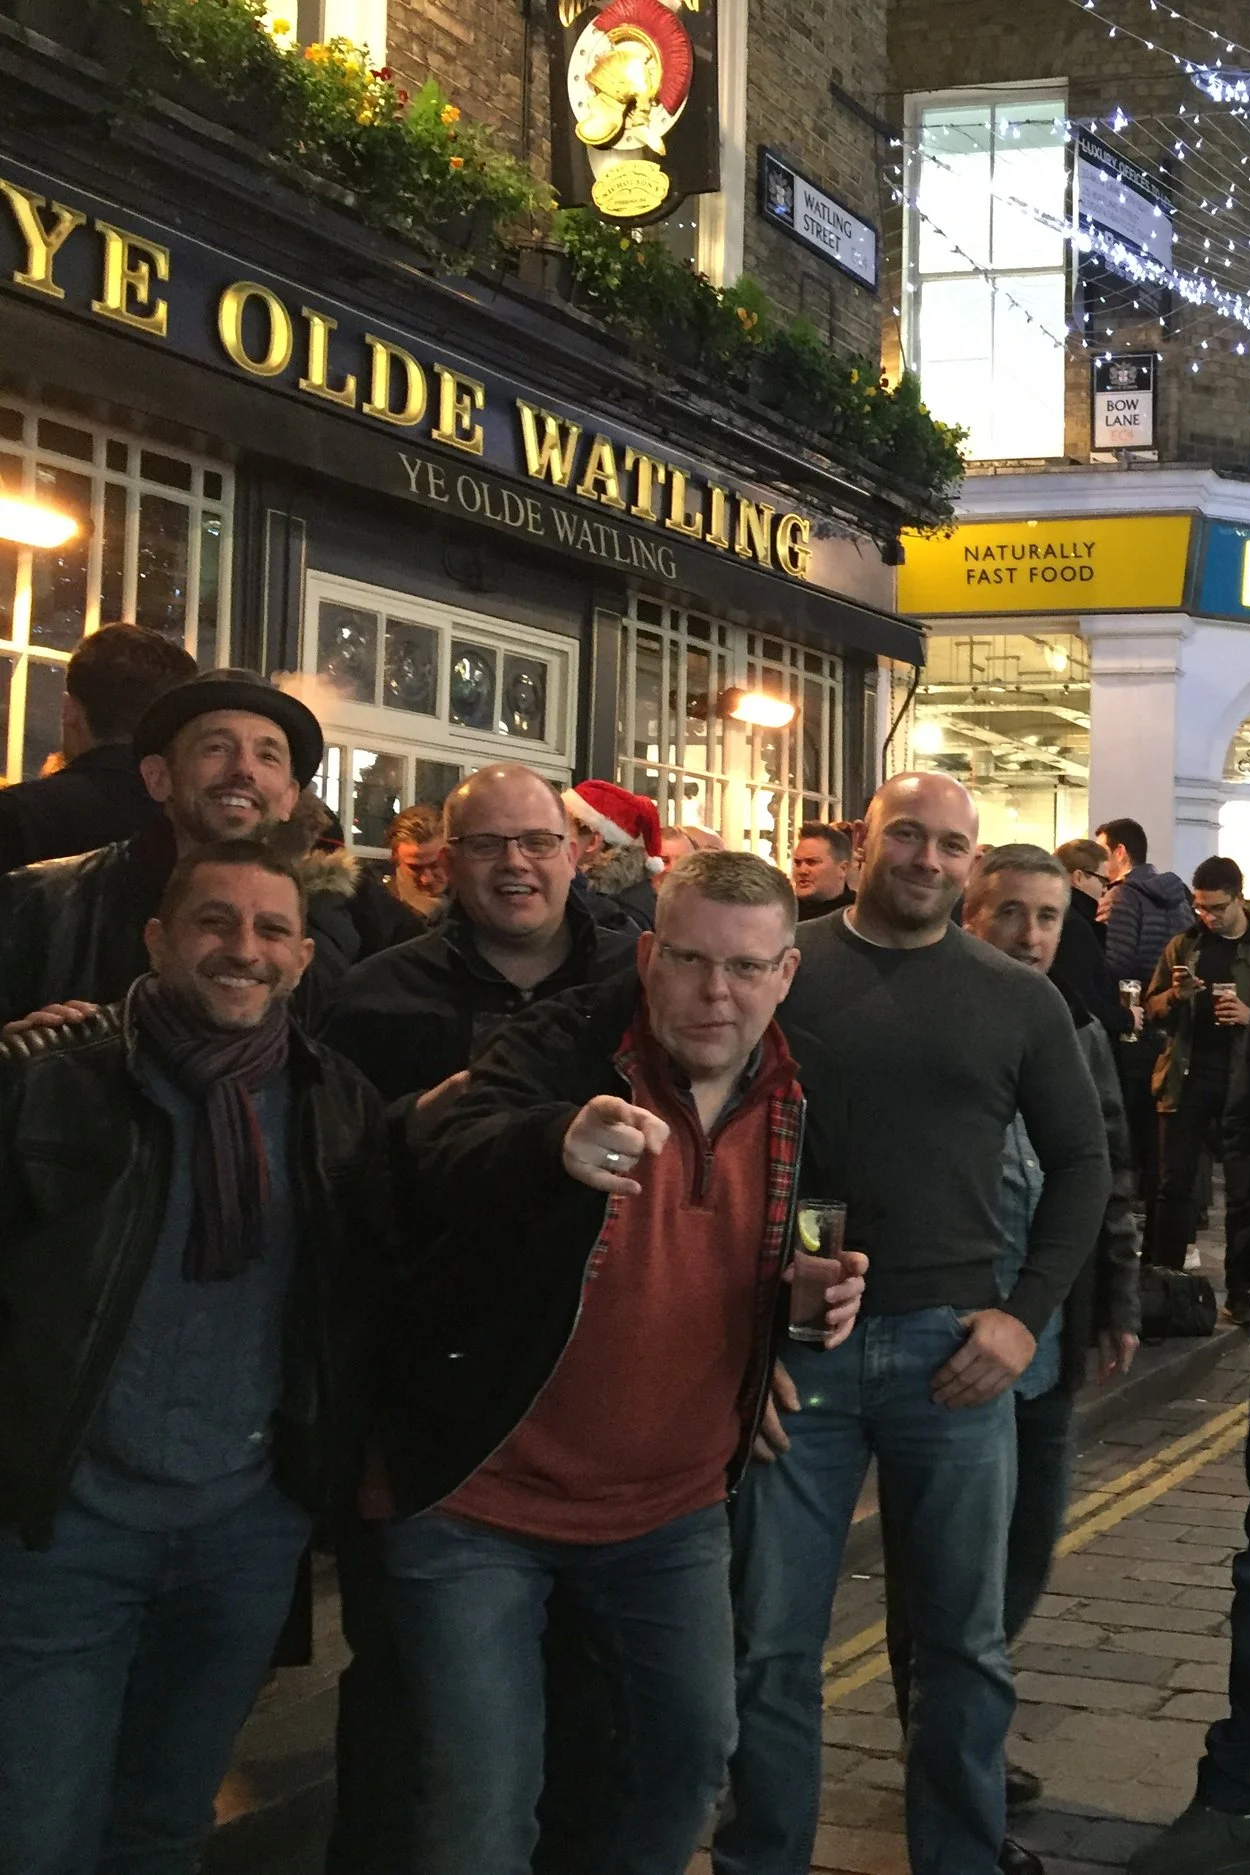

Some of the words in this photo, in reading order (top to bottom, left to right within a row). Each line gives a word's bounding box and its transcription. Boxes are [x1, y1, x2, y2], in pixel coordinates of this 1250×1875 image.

[1082, 138, 1118, 168] LUXURY
[1119, 161, 1150, 190] OFFICES
[803, 189, 853, 240] WATLING
[803, 213, 842, 253] STREET
[0, 176, 170, 338] YE
[217, 279, 486, 456] OLDE
[515, 397, 813, 581] WATLING
[1105, 414, 1140, 427] LANE
[1106, 399, 1139, 412] BOW
[398, 451, 449, 502] YE
[456, 474, 546, 535] OLDE
[550, 506, 677, 579] WATLING
[964, 541, 1096, 562] NATURALLY
[966, 567, 1018, 585] FAST
[1029, 565, 1094, 583] FOOD
